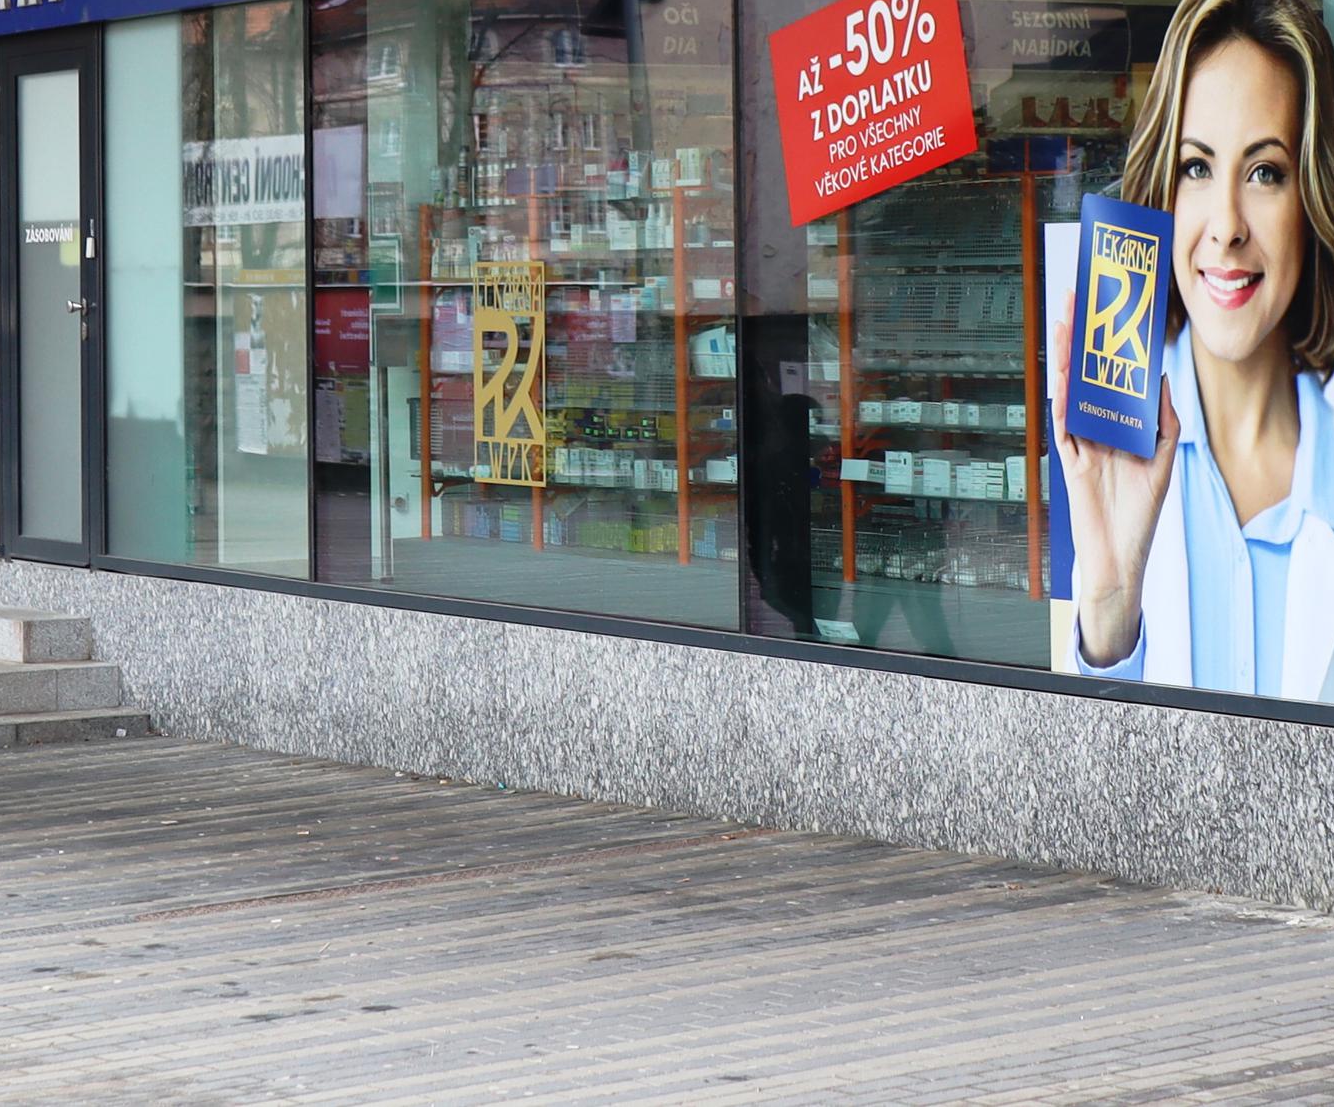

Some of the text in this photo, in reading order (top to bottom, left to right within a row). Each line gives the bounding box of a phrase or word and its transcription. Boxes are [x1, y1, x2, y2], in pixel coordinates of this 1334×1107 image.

[663, 2, 699, 25] OČI
[1011, 8, 1091, 29] SEZONNÍ
[663, 36, 698, 54] DIA
[1012, 35, 1092, 57] NABÍDKA
[798, 56, 824, 102] AŽ
[811, 59, 932, 141] Z DOPLATKU
[829, 105, 922, 163] PRO VŠECHNY
[815, 125, 946, 198] VĚKOVÉ KATEGORIE
[25, 223, 73, 243] ZÁSOBOVÁNÍ
[1095, 228, 1155, 273] LÉKÁRNA
[1096, 352, 1135, 392] WPK
[1120, 414, 1143, 430] KARTA
[489, 441, 532, 481] WPK
